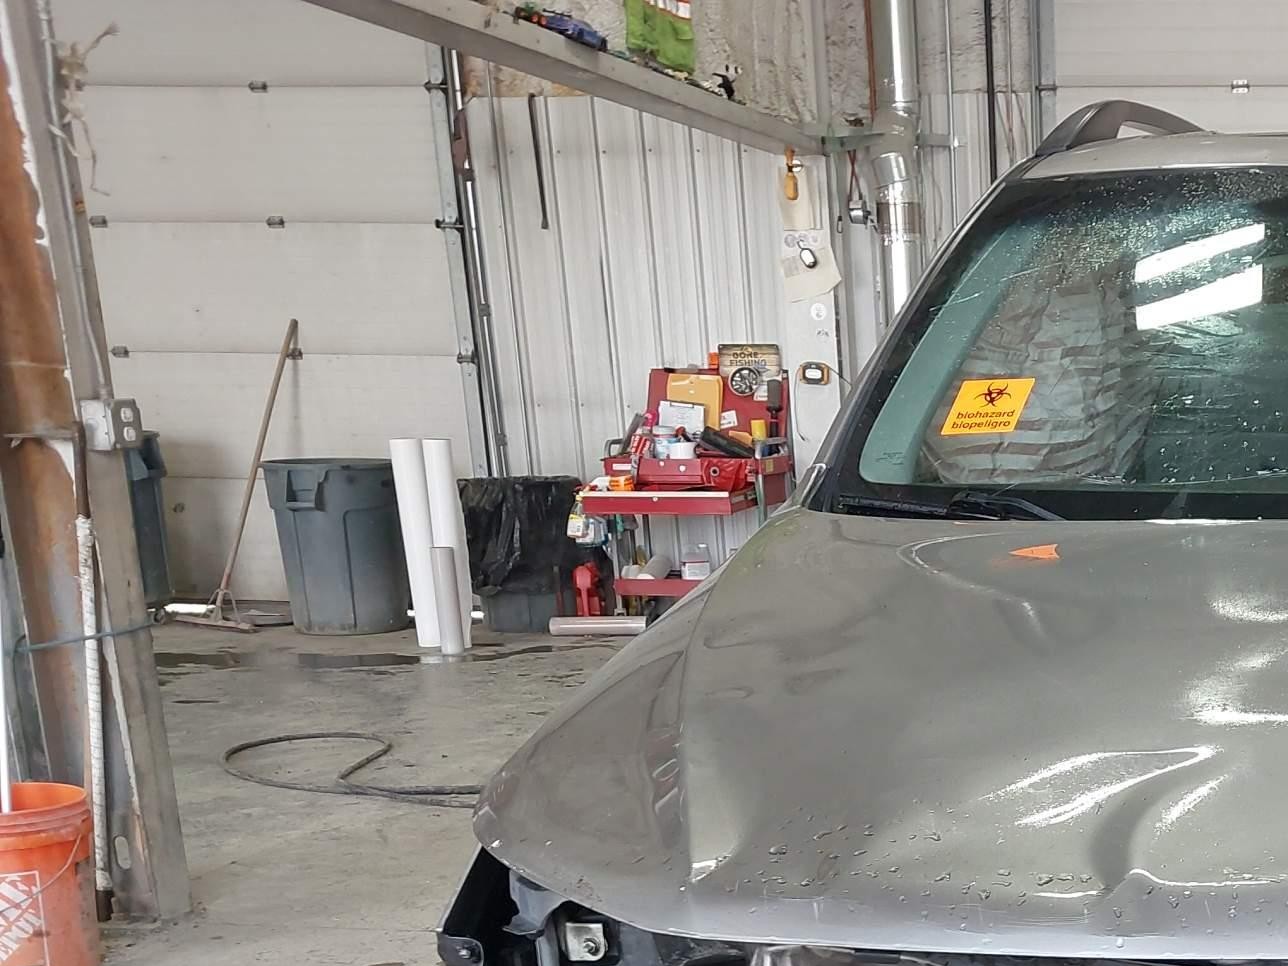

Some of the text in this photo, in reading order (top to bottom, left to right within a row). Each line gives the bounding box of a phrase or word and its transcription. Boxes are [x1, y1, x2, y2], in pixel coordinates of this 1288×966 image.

[729, 359, 767, 367] FISHING
[956, 410, 1015, 419] biohazard
[952, 420, 1011, 430] biopeligro
